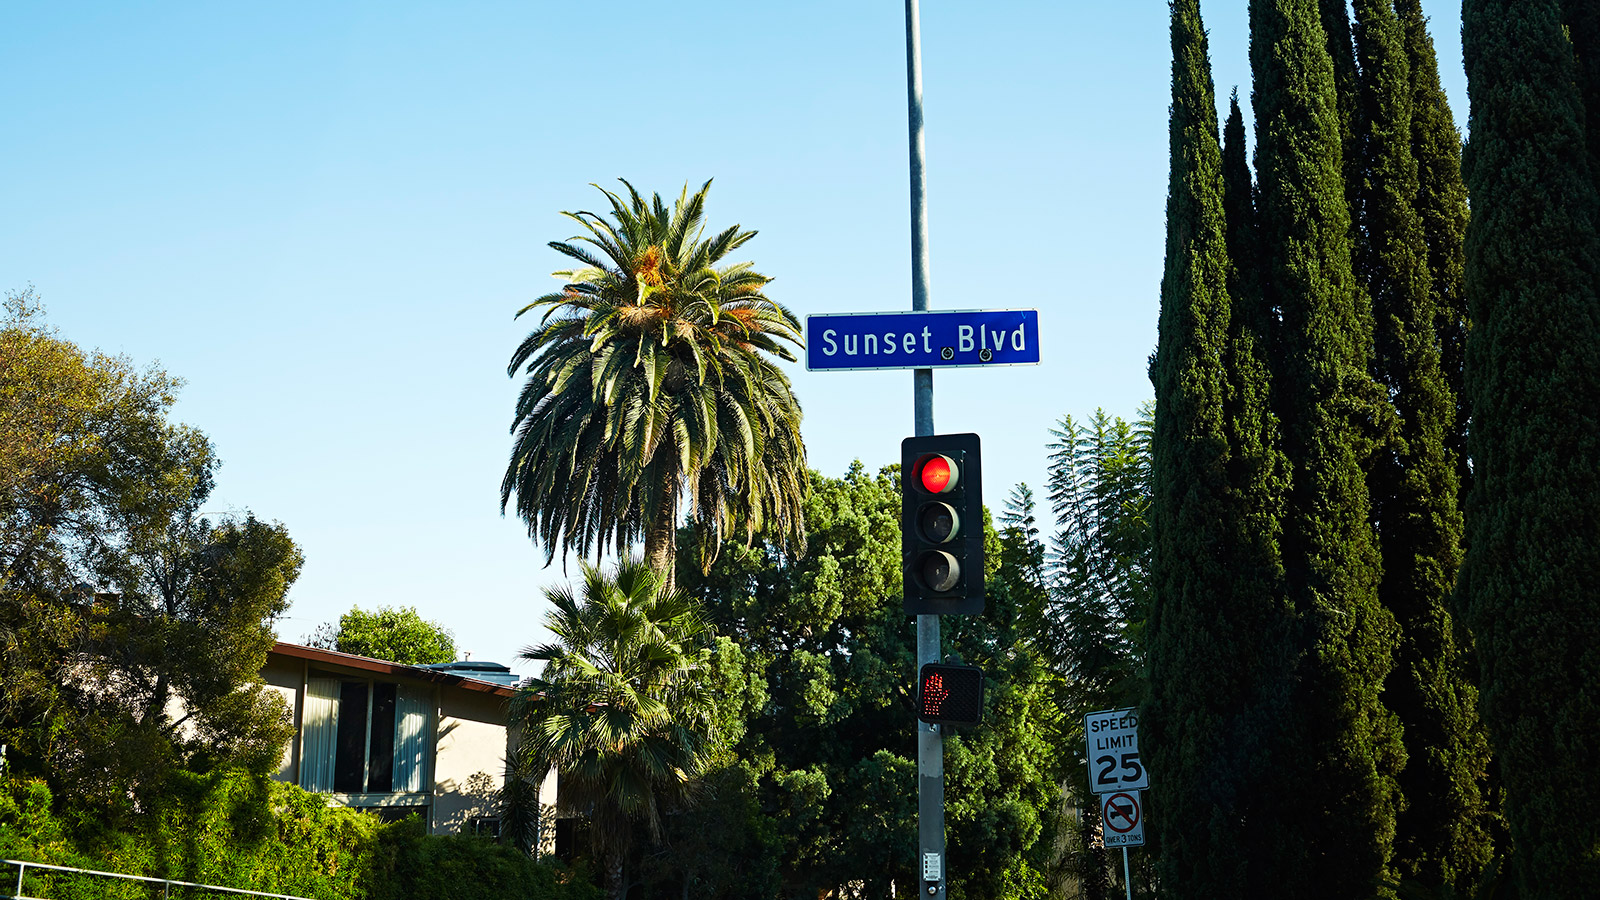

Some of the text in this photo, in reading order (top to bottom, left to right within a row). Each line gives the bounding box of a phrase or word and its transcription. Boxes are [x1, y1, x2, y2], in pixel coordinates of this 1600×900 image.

[822, 322, 1026, 356] Sunset Blvd
[1091, 716, 1138, 733] SPEED
[1096, 734, 1134, 750] LIMIT
[1095, 753, 1143, 785] 25
[1106, 834, 1142, 844] OVER 3 TONS
